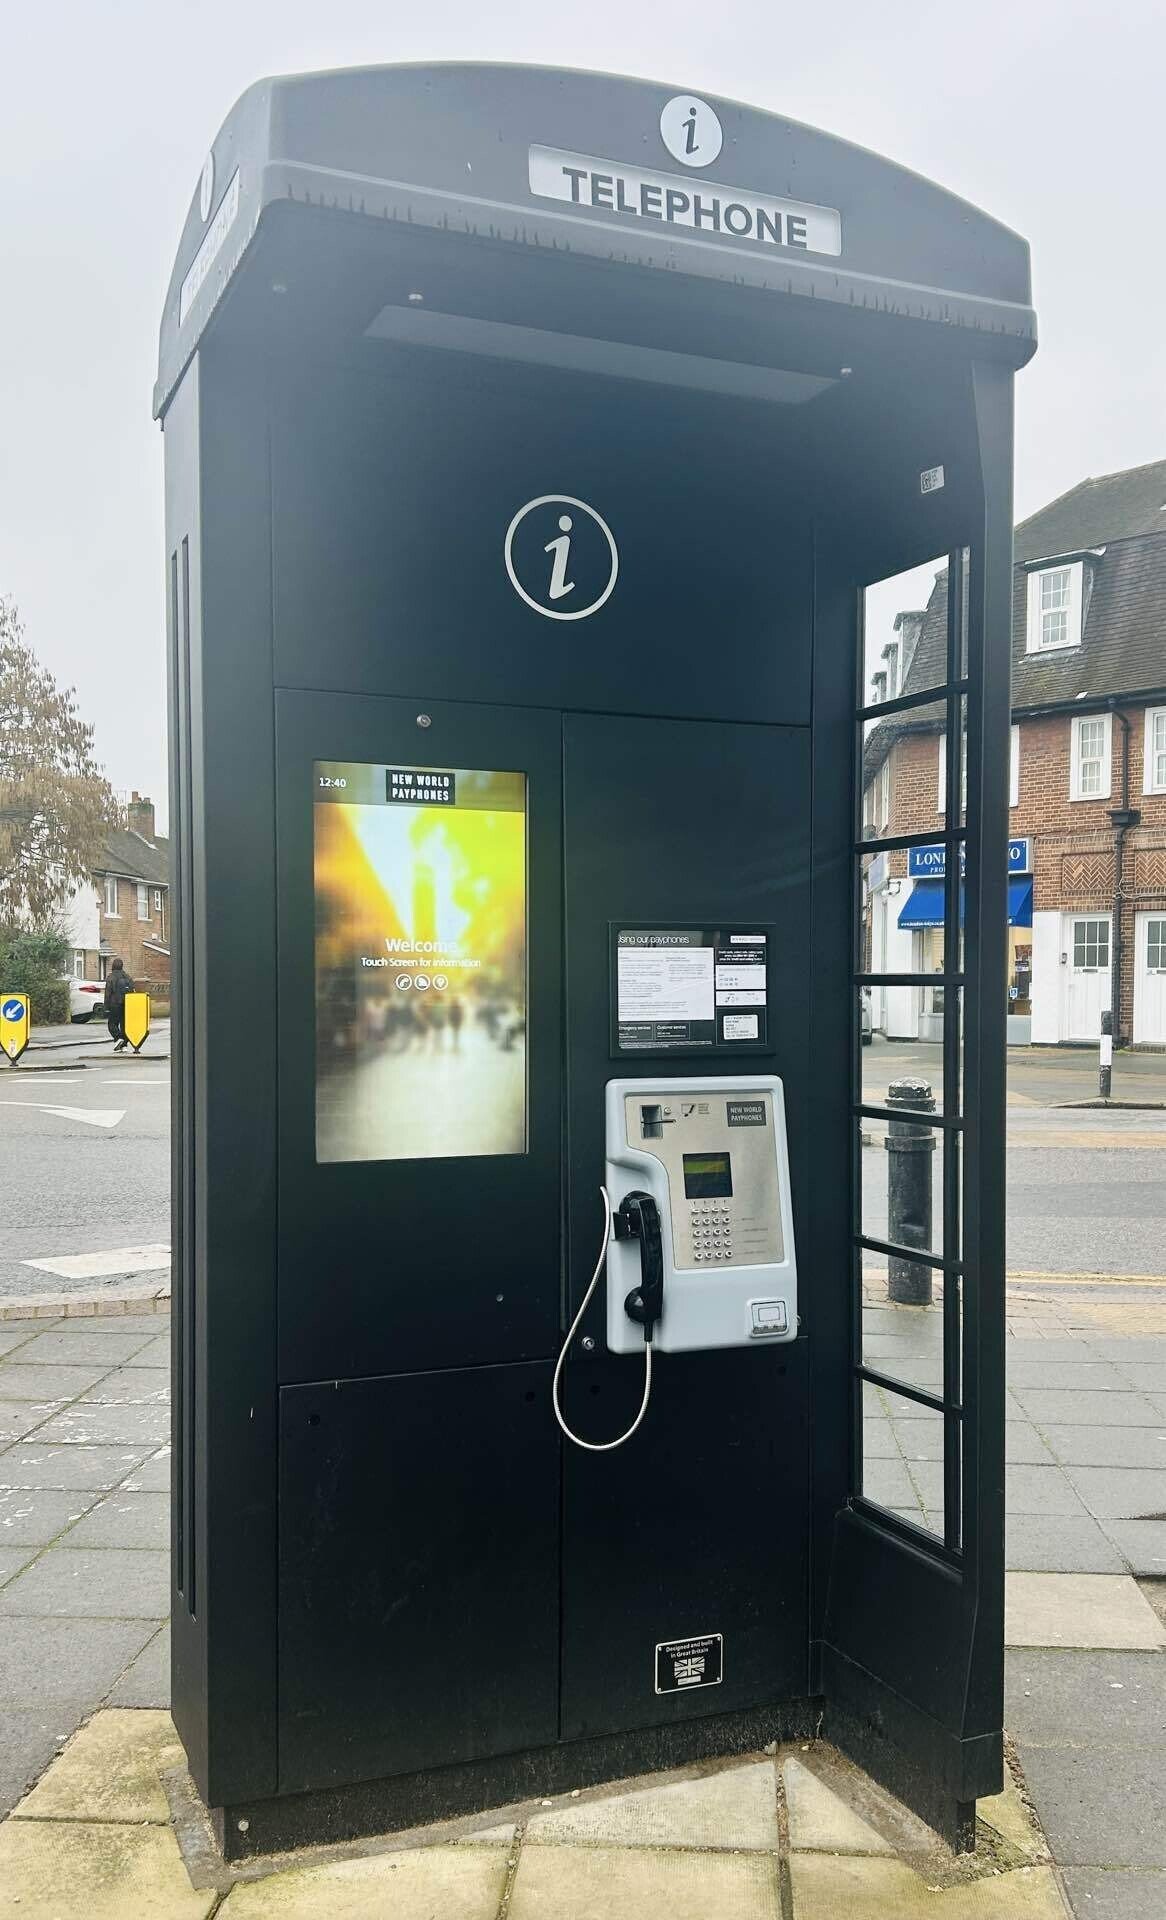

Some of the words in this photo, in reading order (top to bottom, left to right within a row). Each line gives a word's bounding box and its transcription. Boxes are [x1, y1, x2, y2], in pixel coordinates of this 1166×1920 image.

[562, 167, 807, 249] TELEPHONE
[319, 777, 347, 788] 12:40
[392, 773, 412, 785] NEW
[417, 775, 449, 787] WORLD
[392, 788, 449, 801] PAYPHONES
[385, 938, 457, 953] Welcome
[650, 936, 690, 945] payphones
[361, 957, 388, 967] Touch
[389, 957, 418, 967] Screen
[419, 957, 432, 967] for
[433, 957, 481, 968] information
[666, 1643, 690, 1653] Designed
